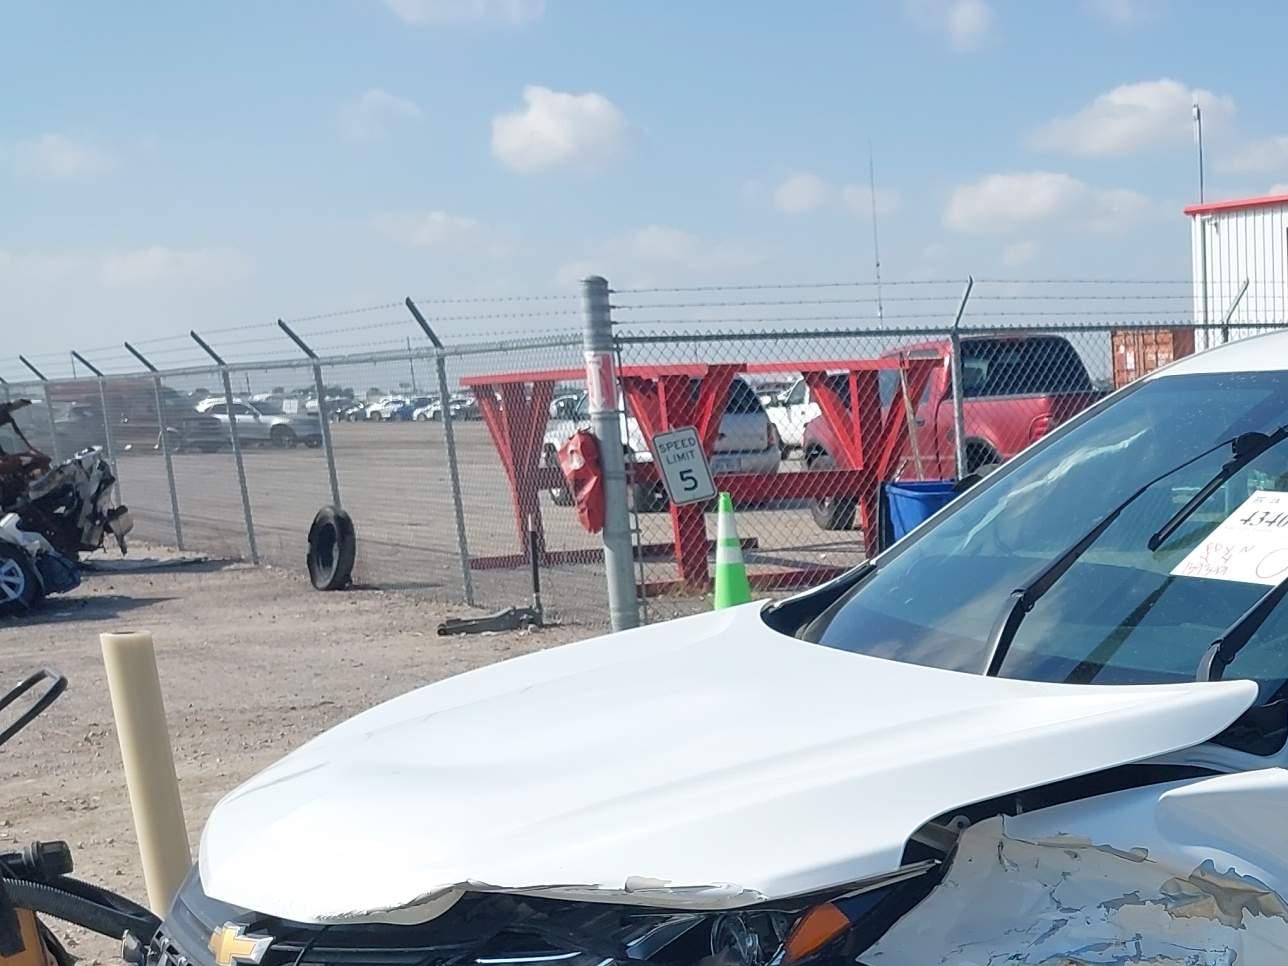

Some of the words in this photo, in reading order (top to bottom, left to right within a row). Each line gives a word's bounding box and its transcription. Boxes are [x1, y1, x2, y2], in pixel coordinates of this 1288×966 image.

[659, 437, 696, 453] SPEED
[666, 450, 695, 464] LIMIT
[679, 468, 698, 491] 5
